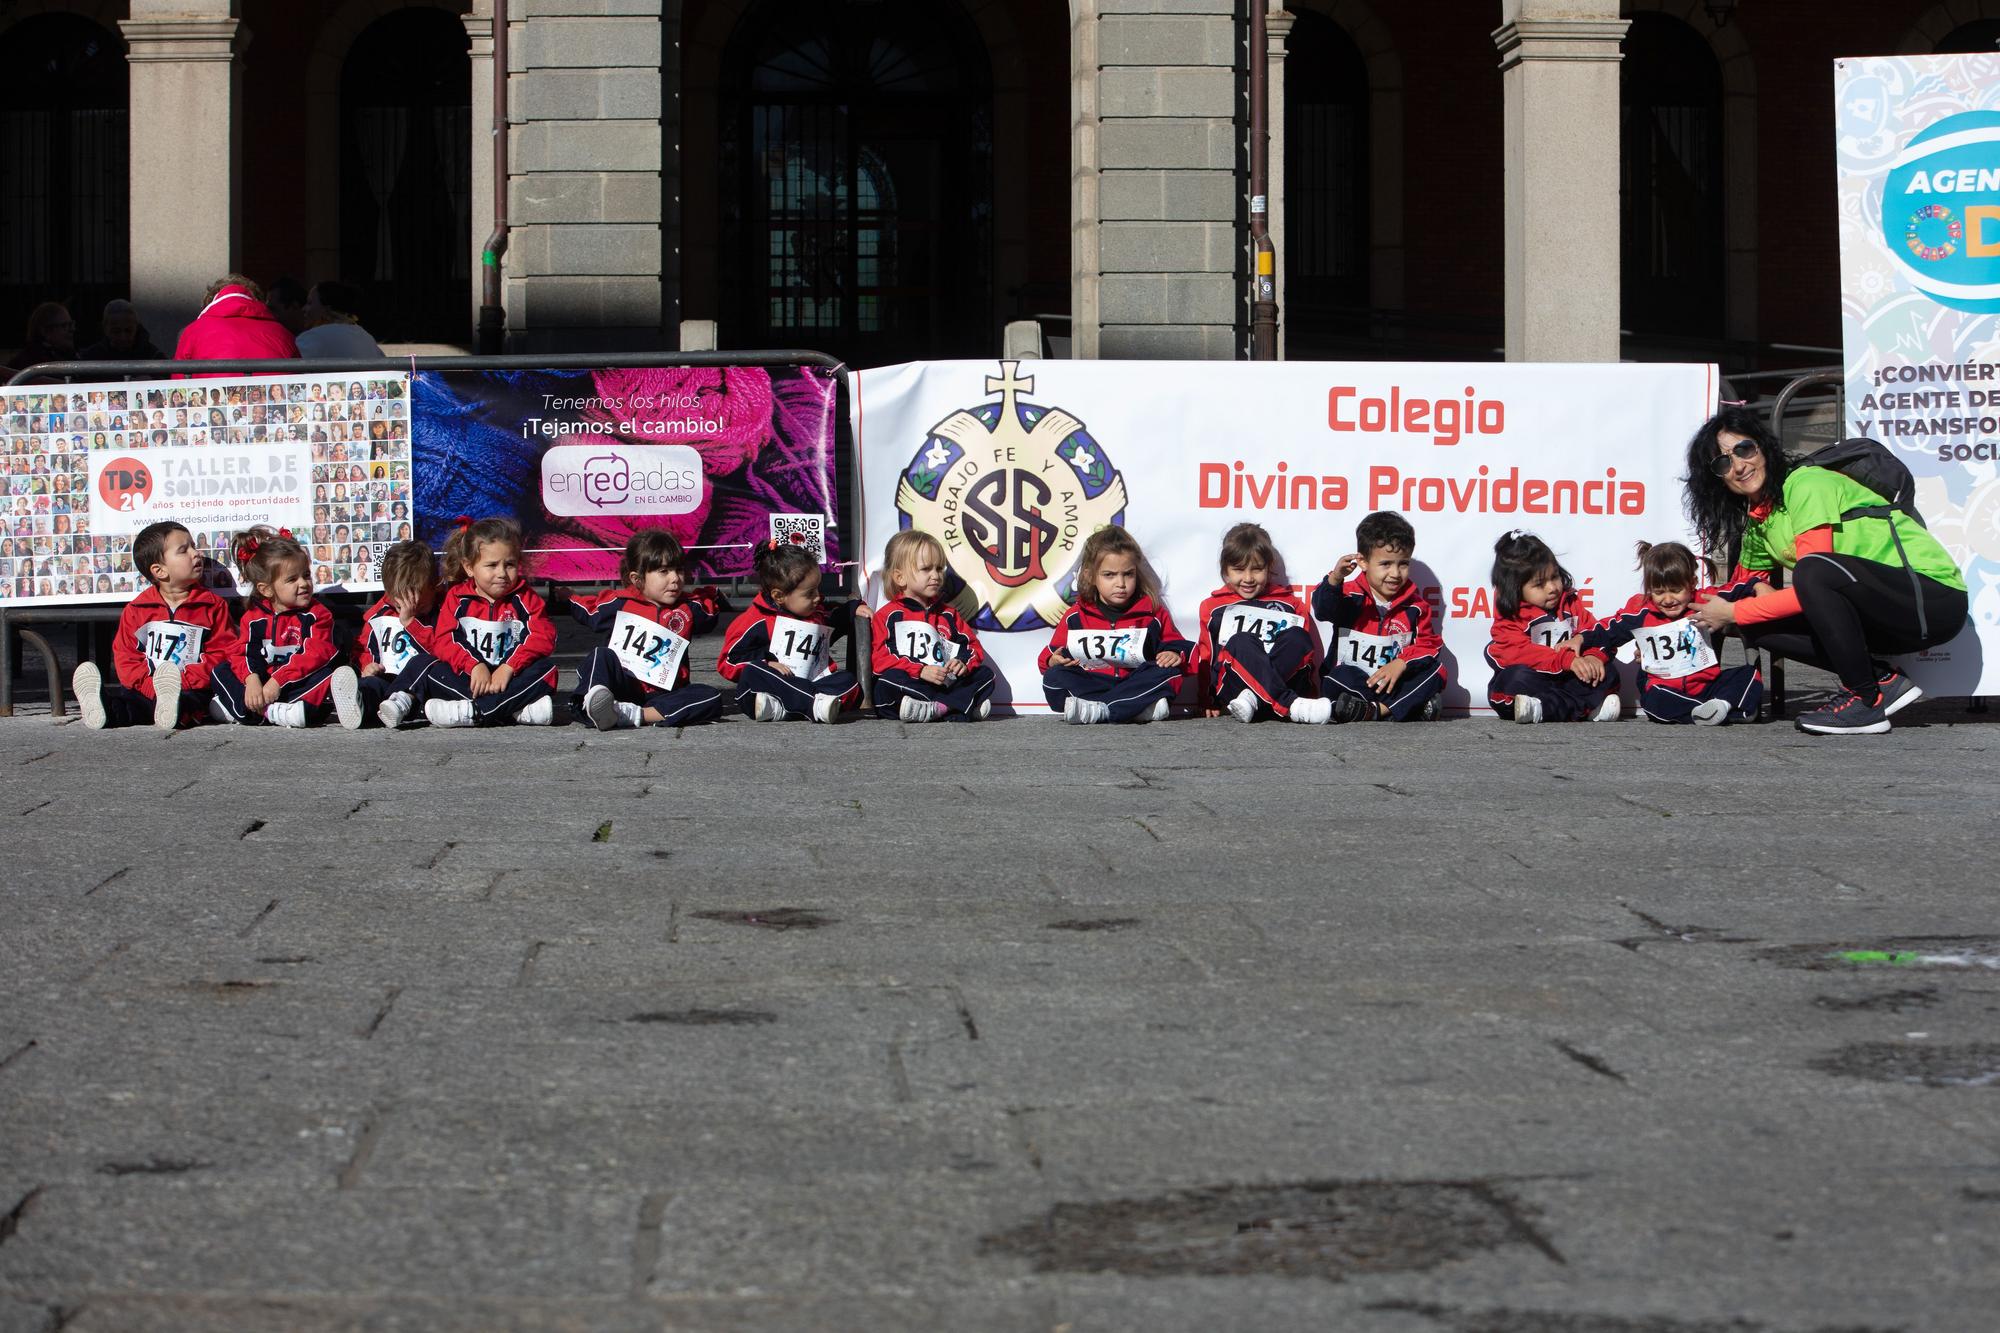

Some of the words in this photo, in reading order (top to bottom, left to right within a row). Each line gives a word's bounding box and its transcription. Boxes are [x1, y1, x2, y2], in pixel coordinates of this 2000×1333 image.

[1904, 168, 2000, 195] AGEN
[542, 394, 623, 410] Tenemos
[629, 394, 654, 409] los
[1860, 391, 1961, 411] AGENTE
[1327, 385, 1505, 446] Colegio
[1856, 420, 1872, 437] Y
[1879, 416, 2000, 437] TRANSFO
[523, 418, 613, 439] ¡Tejamos
[619, 417, 637, 434] el
[642, 416, 724, 434] cambio!
[1938, 443, 2000, 462] SOCI
[161, 456, 250, 477] TALLER
[268, 454, 297, 473] DE
[549, 461, 696, 493] enredadas
[105, 469, 147, 490] TDS
[164, 475, 298, 497] SOLIDARIDAD
[1199, 460, 1349, 511] Divina
[1368, 465, 1646, 516] Providencia
[120, 492, 145, 511] 20
[152, 500, 174, 509] años
[180, 499, 224, 510] tejiendo
[228, 496, 300, 507] oportunidades
[634, 496, 647, 504] EN
[648, 495, 657, 504] EL
[659, 494, 692, 503] CAMBIO
[943, 461, 979, 552] TRABAJO
[994, 447, 1016, 463] FE
[1042, 459, 1055, 473] Y
[1058, 490, 1079, 552] AMOR
[1234, 615, 1278, 643] 143
[148, 631, 180, 660] 147
[622, 625, 664, 662] 142
[1078, 636, 1124, 659] 137
[1349, 640, 1393, 669] 145
[1646, 631, 1692, 660] 134
